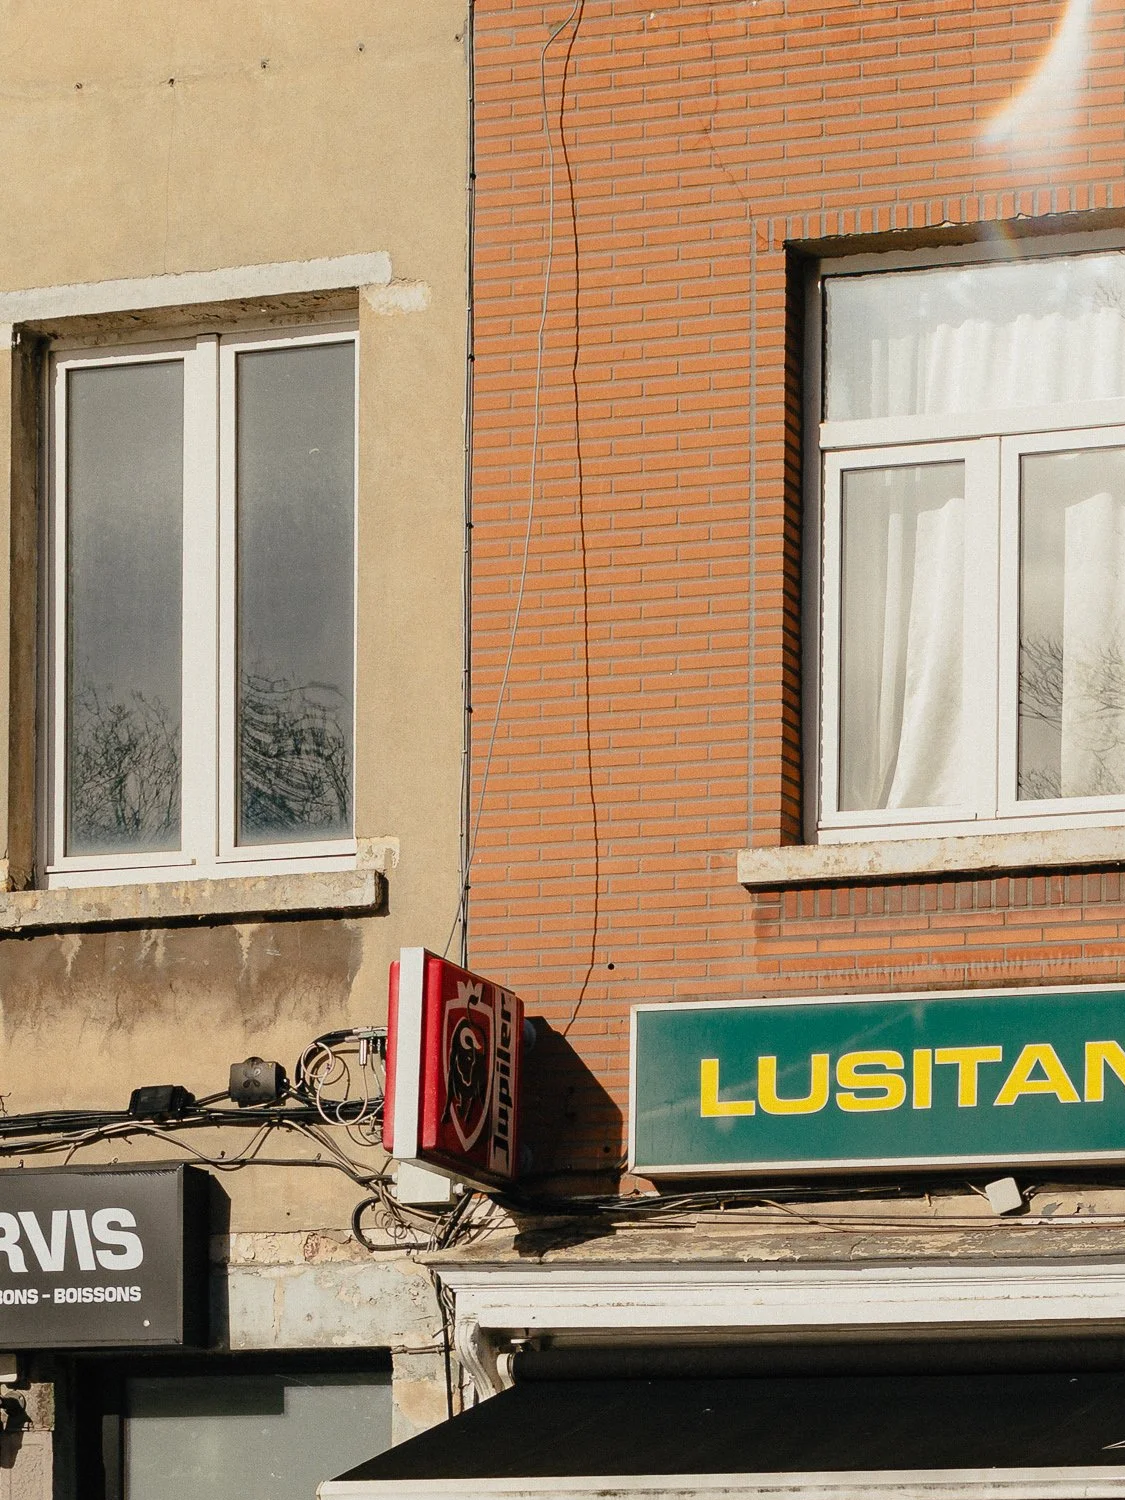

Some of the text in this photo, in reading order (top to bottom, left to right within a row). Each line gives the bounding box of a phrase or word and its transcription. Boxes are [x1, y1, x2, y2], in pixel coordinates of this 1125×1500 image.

[493, 992, 513, 1168] Jupiler
[0, 1207, 144, 1273] RVIS
[0, 1288, 39, 1305] ONS
[54, 1286, 142, 1304] BOISSONS
